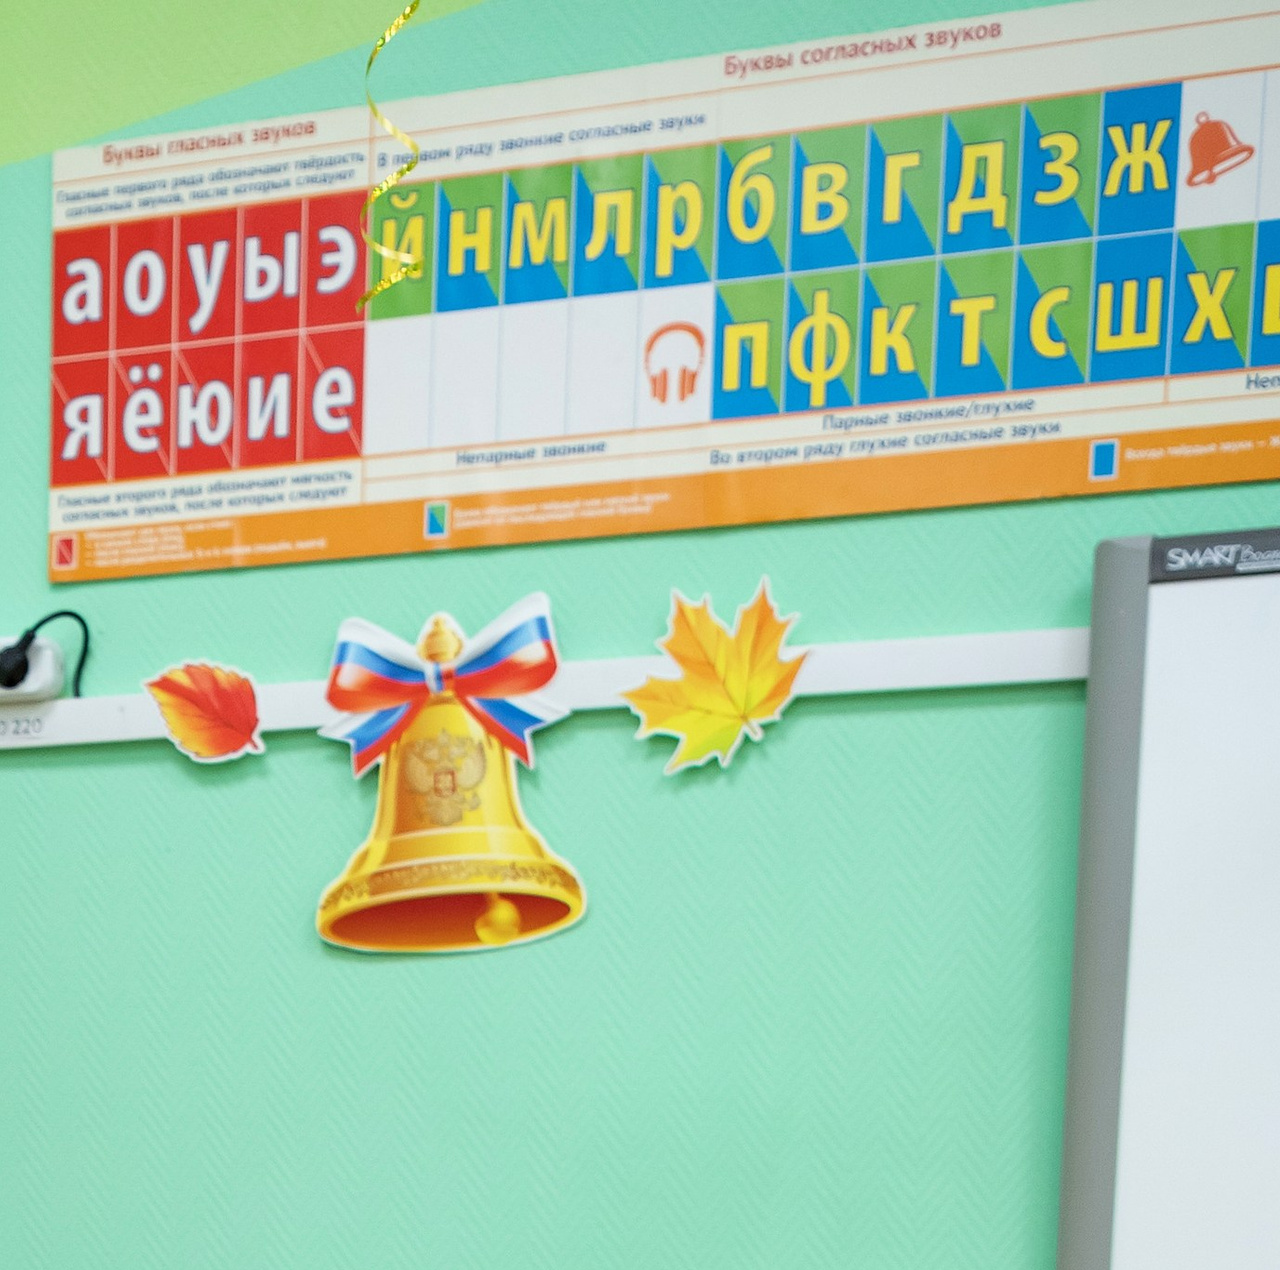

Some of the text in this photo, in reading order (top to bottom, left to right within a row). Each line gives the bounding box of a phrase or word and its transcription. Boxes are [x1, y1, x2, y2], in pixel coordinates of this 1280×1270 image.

[724, 22, 1003, 79] Буквы согласных звуков
[102, 121, 317, 166] Буквы гласных звуков
[455, 140, 493, 161] ряду
[499, 131, 563, 152] звонкие
[568, 119, 652, 142] согласные
[658, 113, 706, 134] звуки
[447, 206, 492, 277] н
[508, 199, 569, 270] м
[585, 189, 634, 261] л
[654, 179, 704, 278] р
[726, 143, 775, 245] б
[799, 161, 849, 235] в
[882, 151, 921, 225] г
[947, 140, 1008, 235] д
[1034, 130, 1081, 206] з
[1102, 119, 1174, 198] ж
[62, 224, 358, 335] а о у ы э
[721, 320, 770, 393] п
[788, 289, 851, 408] ф
[869, 303, 919, 377] к
[949, 296, 996, 368] т
[1030, 286, 1072, 359] с
[1094, 275, 1165, 355] ш
[1183, 268, 1238, 344] х
[61, 363, 356, 461] я ё ю и е
[822, 411, 890, 433] Парные
[456, 441, 607, 468] Непарные звонкие
[710, 421, 1061, 465] Во втором ряду глухие согласные звуки
[1166, 545, 1241, 571] SMART
[12, 718, 43, 736] 220
